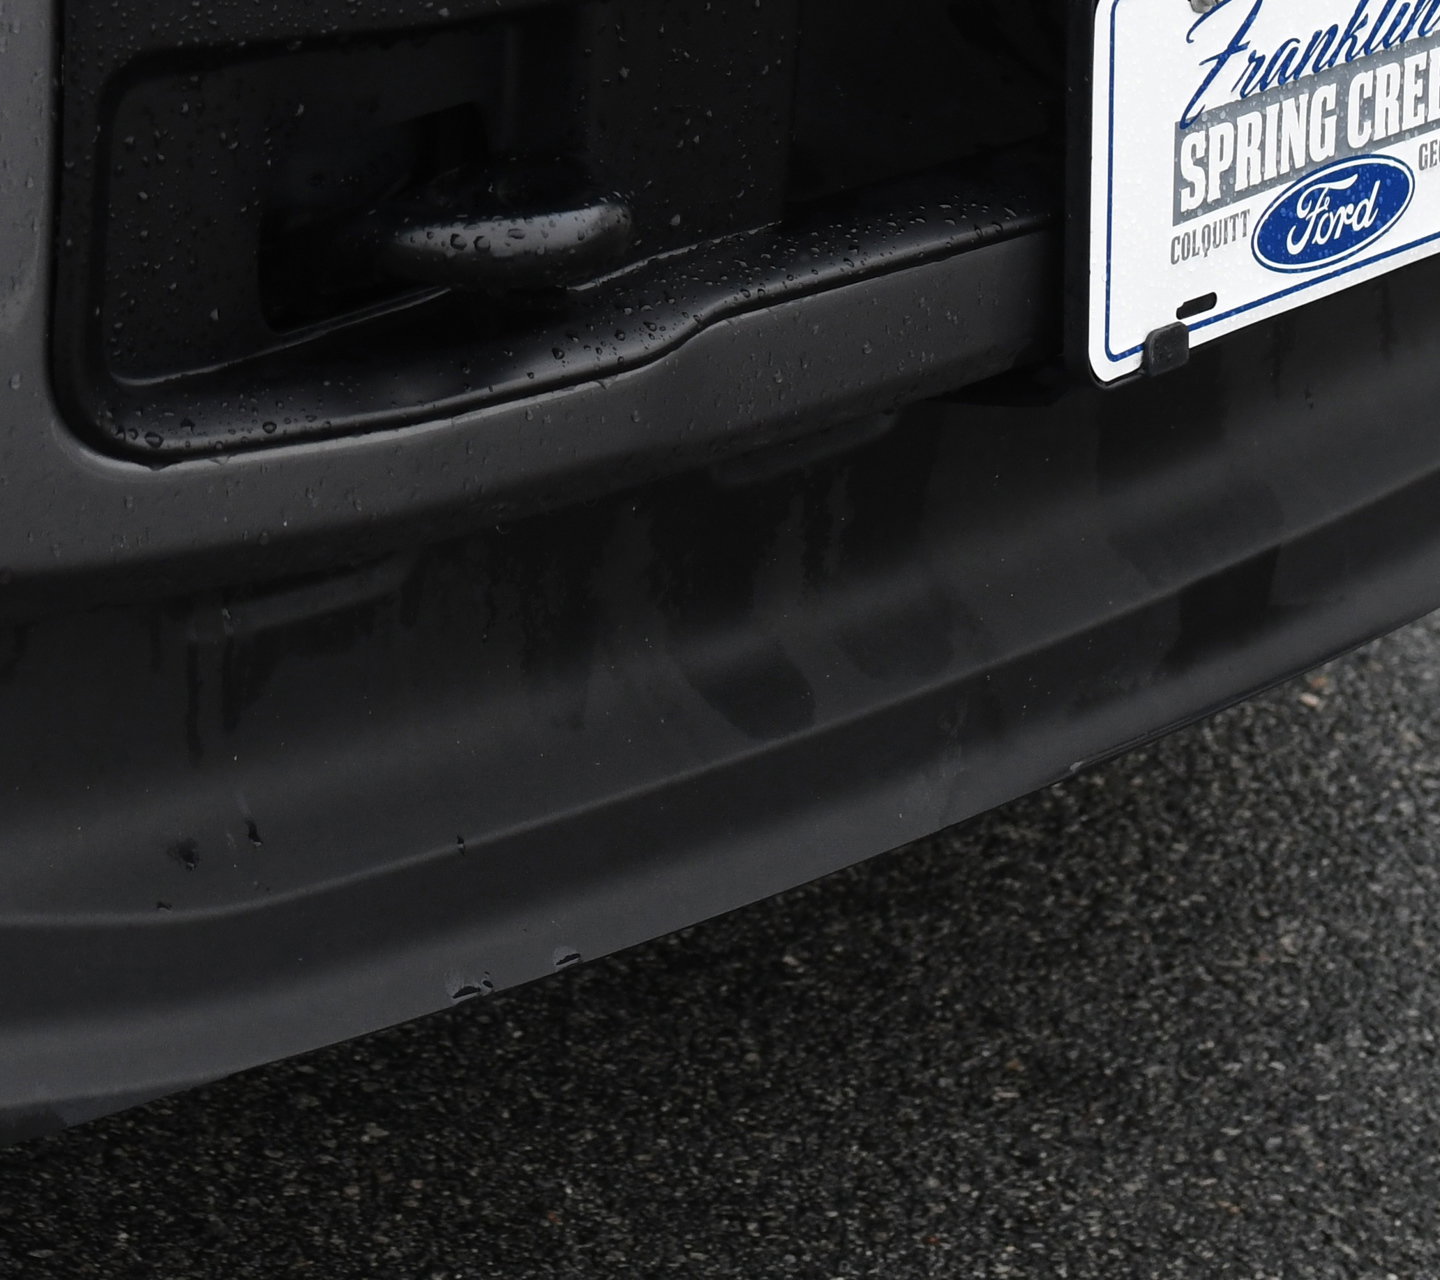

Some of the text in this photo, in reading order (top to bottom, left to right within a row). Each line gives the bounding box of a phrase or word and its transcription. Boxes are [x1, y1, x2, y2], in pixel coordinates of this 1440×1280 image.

[1179, 81, 1338, 213] SPRING
[1169, 207, 1251, 266] COLQUITT
[1285, 171, 1380, 256] Ford
